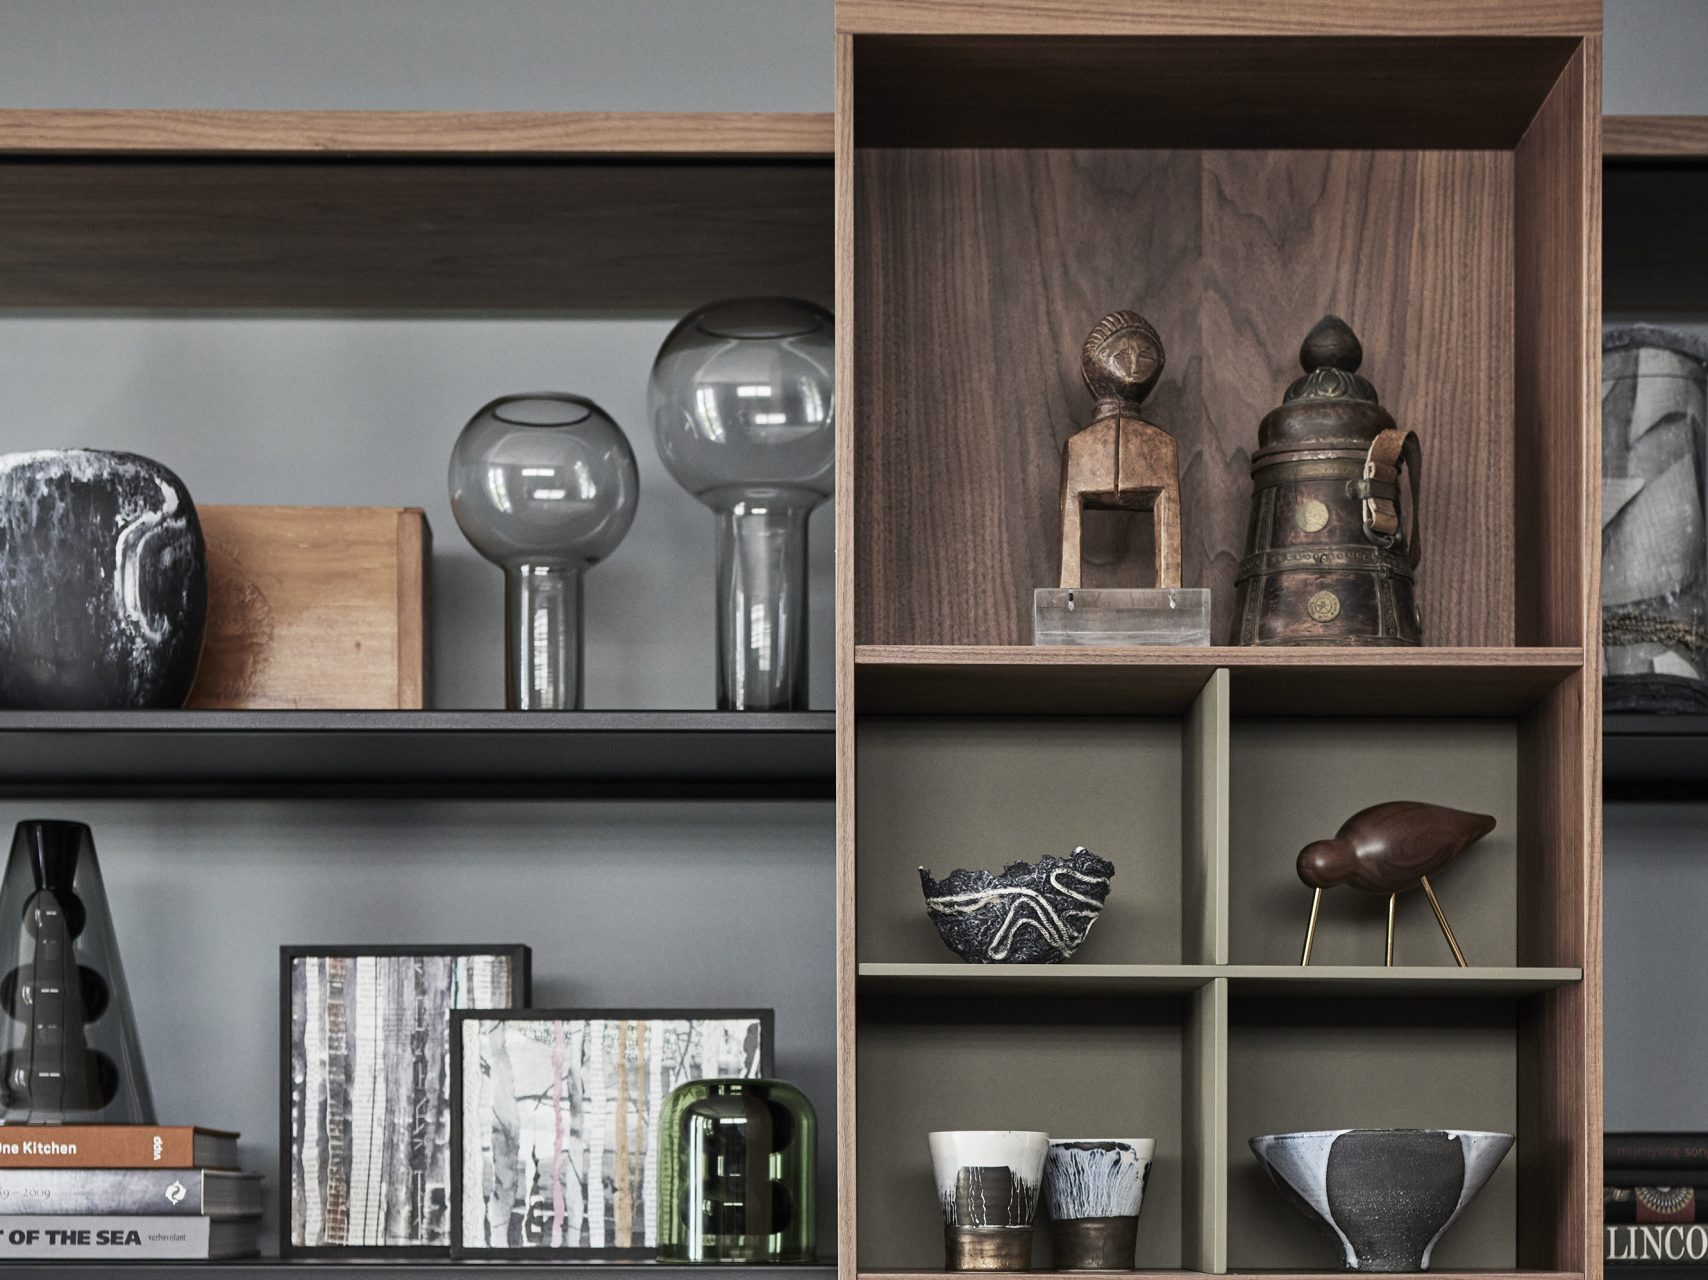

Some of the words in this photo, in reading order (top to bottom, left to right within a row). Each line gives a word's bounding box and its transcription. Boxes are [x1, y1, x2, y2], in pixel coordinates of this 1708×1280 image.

[23, 1141, 77, 1154] Kitchen
[1684, 1147, 1708, 1159] son
[8, 1230, 40, 1246] OF
[45, 1230, 91, 1246] THE
[96, 1230, 142, 1246] SEA
[1606, 1225, 1708, 1260] LINCO
